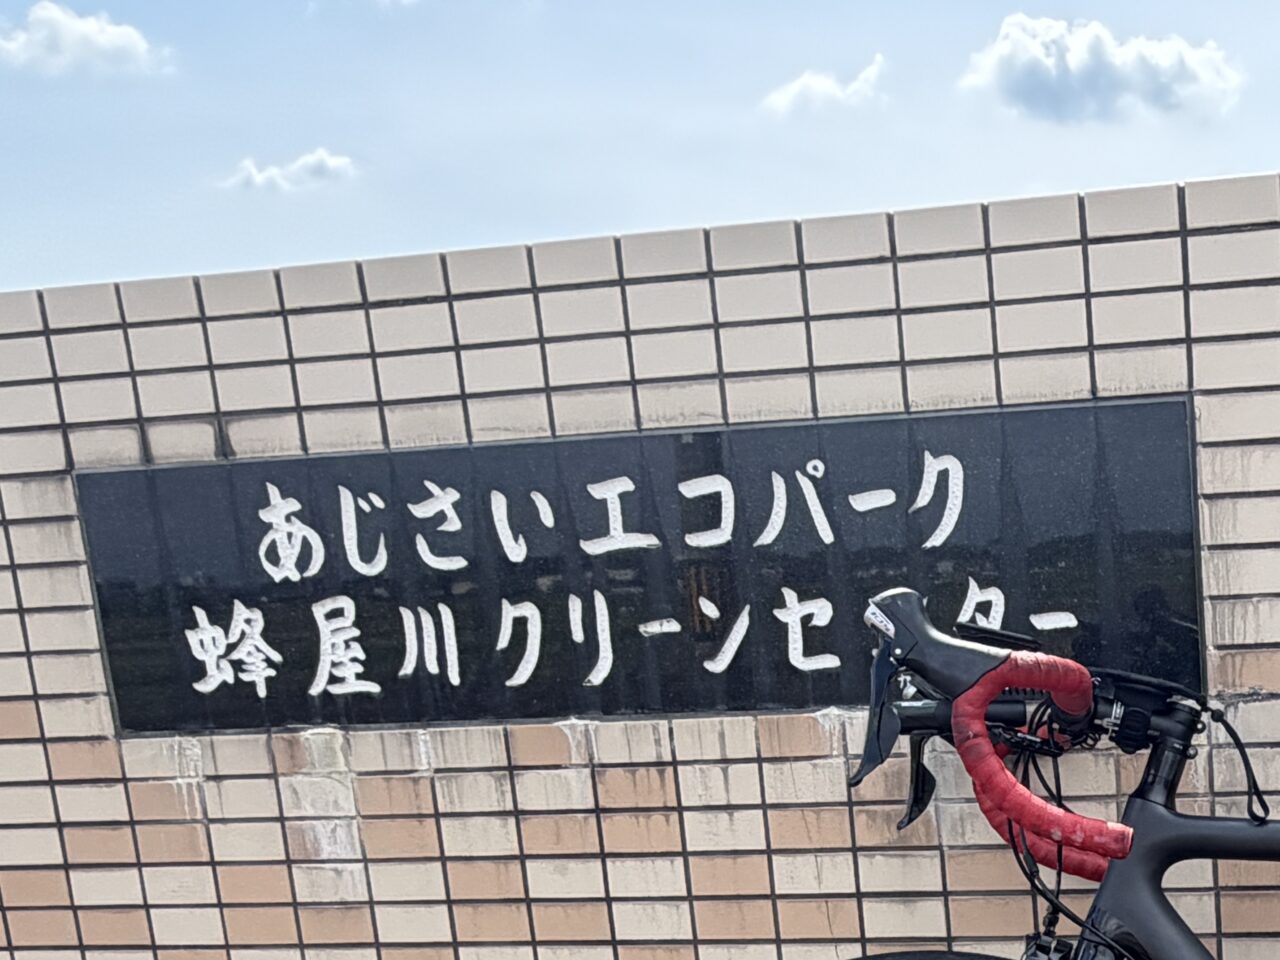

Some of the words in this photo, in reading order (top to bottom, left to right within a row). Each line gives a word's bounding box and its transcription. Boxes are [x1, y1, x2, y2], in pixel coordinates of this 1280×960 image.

[258, 450, 964, 583] あじさいエコパーク
[184, 576, 1078, 699] 蜂屋川クリーンセター
